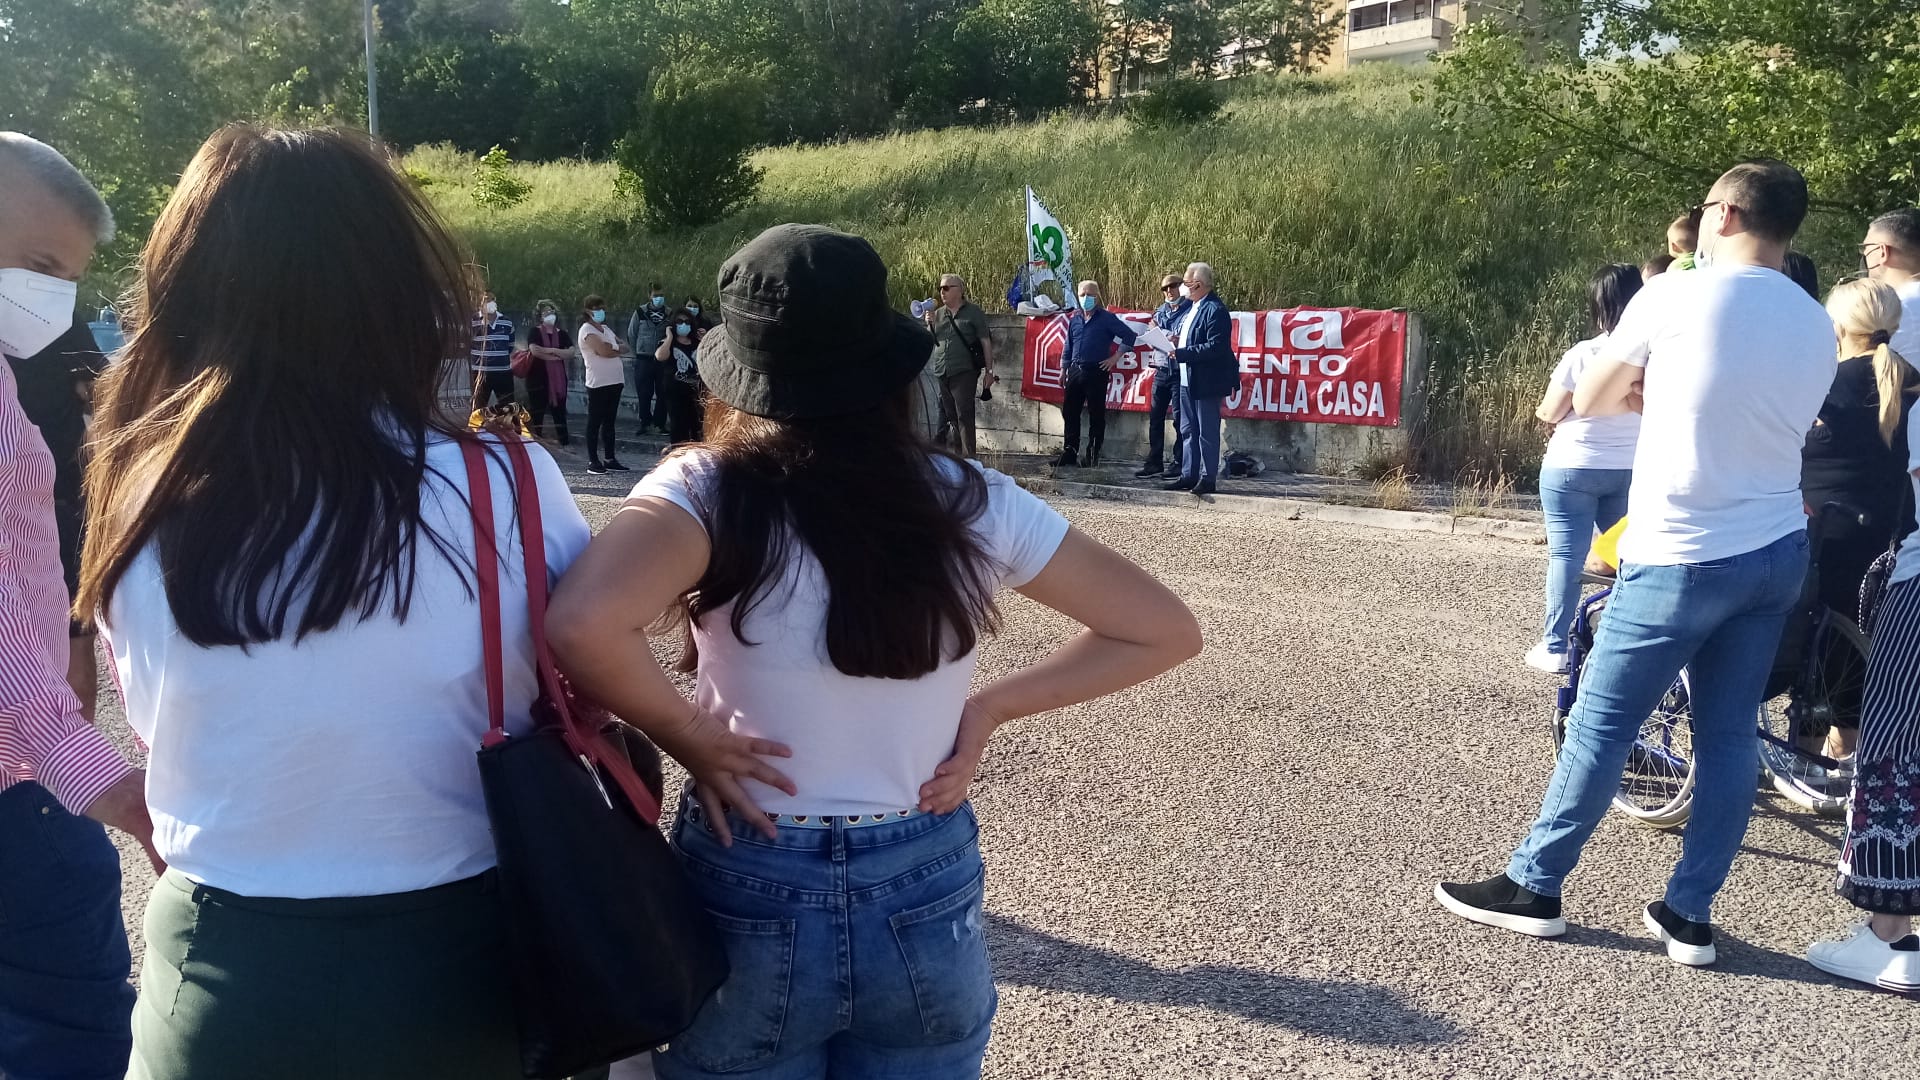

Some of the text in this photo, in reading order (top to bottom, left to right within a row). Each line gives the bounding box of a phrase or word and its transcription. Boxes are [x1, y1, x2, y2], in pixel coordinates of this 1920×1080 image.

[1116, 351, 1348, 376] BEENTO
[1247, 377, 1309, 414] ALLA
[1317, 379, 1385, 417] CASA
